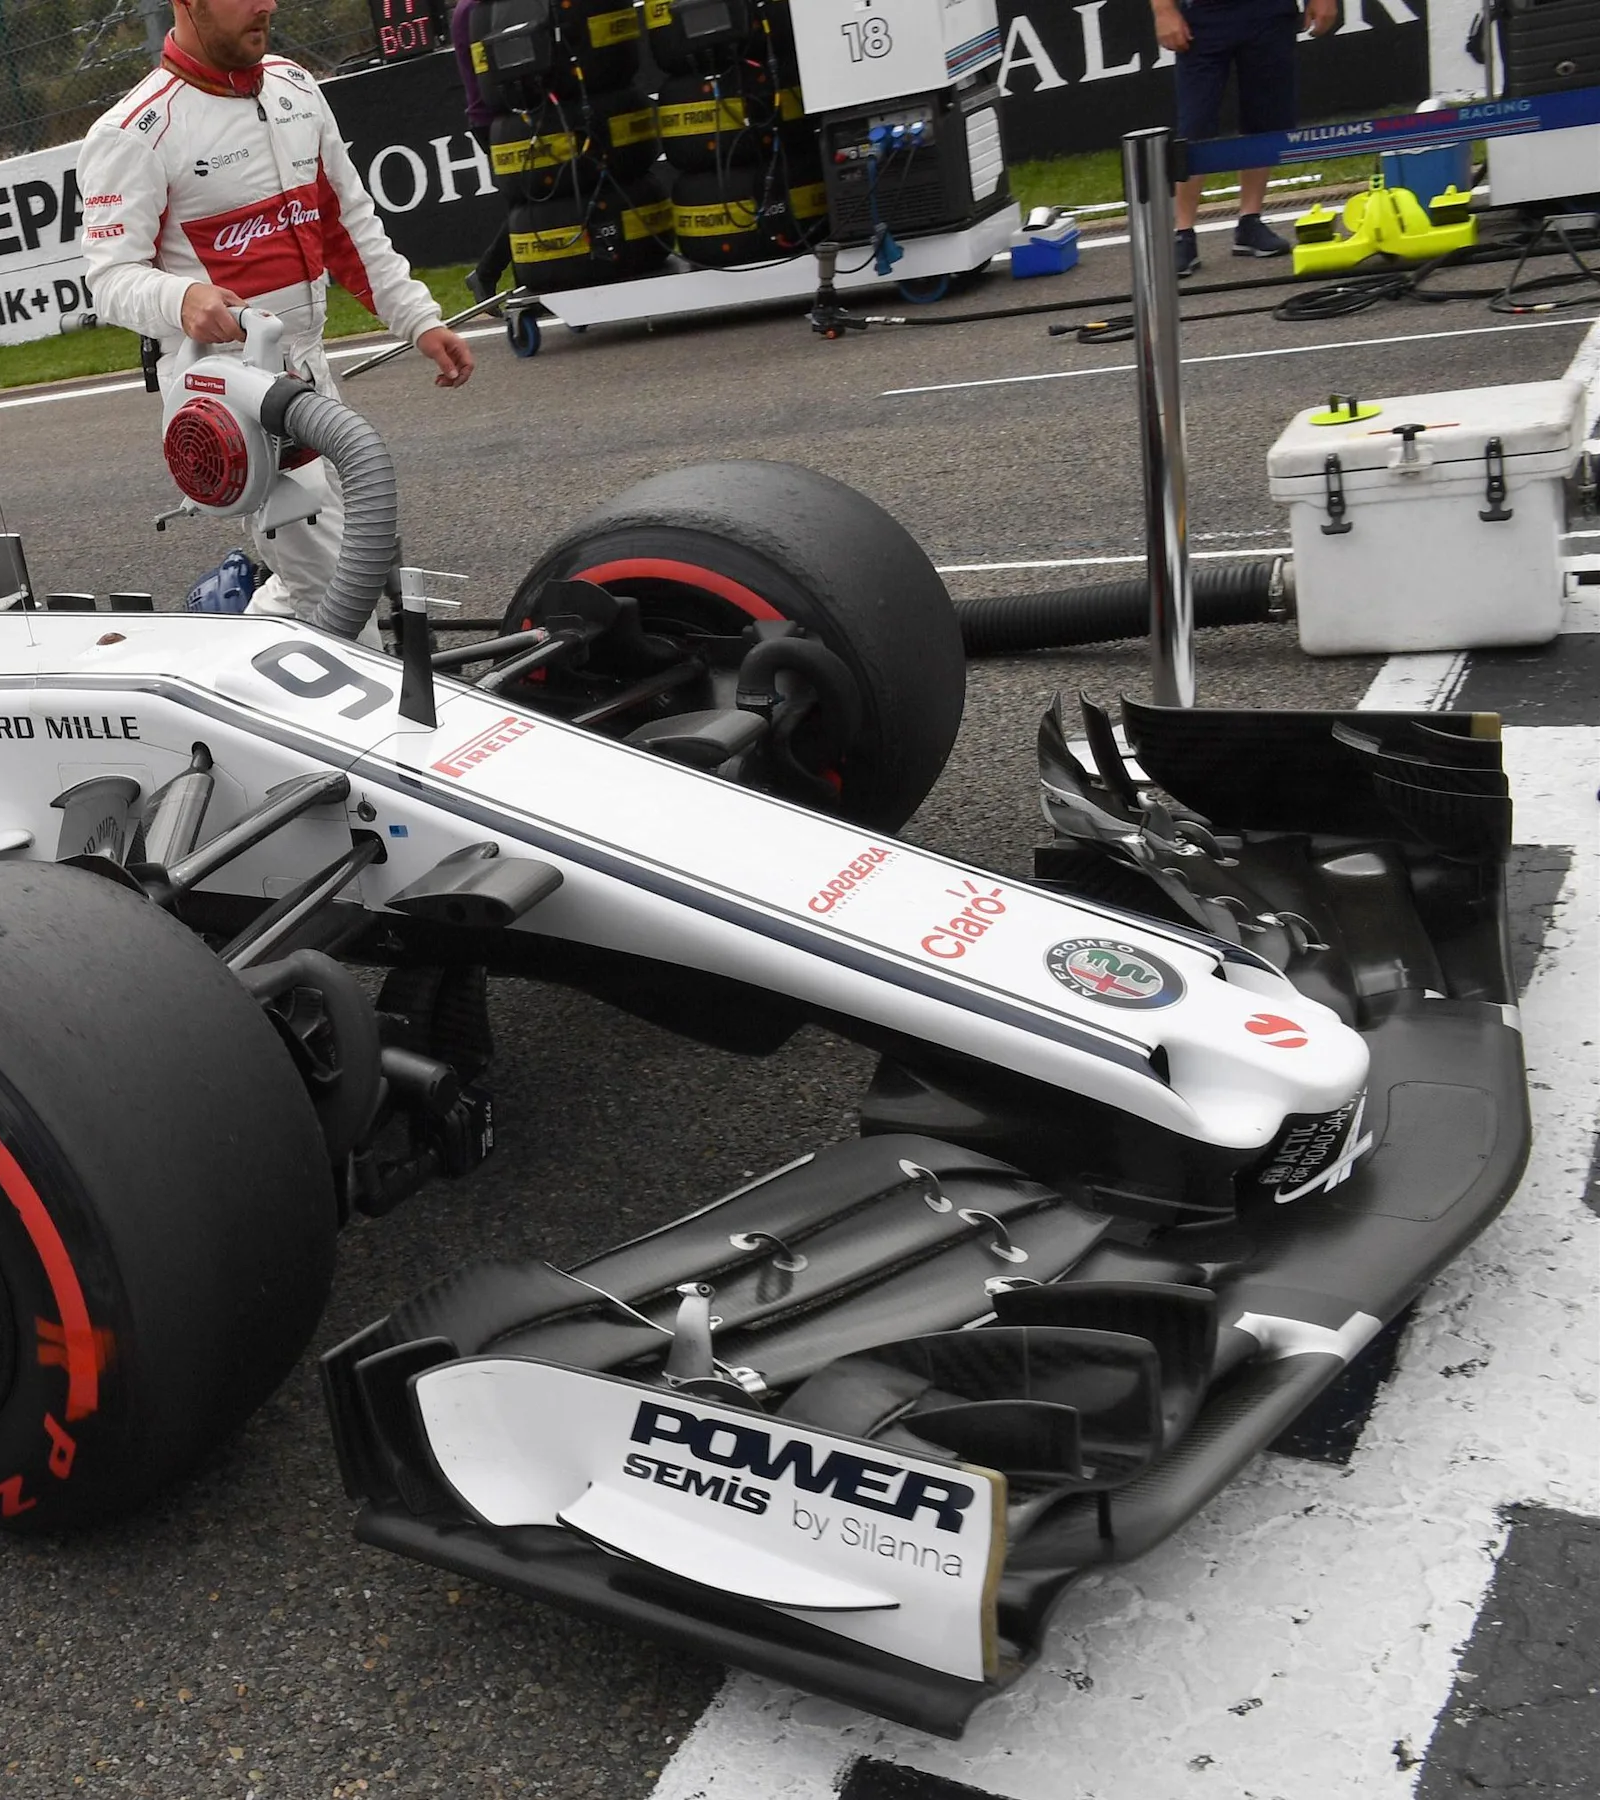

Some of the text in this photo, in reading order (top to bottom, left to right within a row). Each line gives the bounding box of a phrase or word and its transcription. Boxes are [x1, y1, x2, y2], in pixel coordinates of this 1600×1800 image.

[379, 16, 429, 55] BOT
[841, 17, 893, 63] 18
[138, 110, 158, 131] OMP
[1287, 122, 1374, 143] WILLIAMS
[1459, 100, 1531, 121] RACING
[210, 148, 249, 170] Silanna
[84, 194, 123, 206] CARRERA
[214, 214, 276, 256] Alfa
[251, 640, 394, 721] 9
[45, 716, 141, 740] MILLE
[430, 716, 536, 778] PIRELLI
[807, 846, 892, 914] CARRERA
[920, 896, 1007, 959] Claro
[1050, 938, 1135, 998] ALFA ROMEO
[1288, 1166, 1312, 1183] FOR
[1300, 1134, 1336, 1165] ROAD
[44, 1412, 76, 1480] P
[630, 1400, 975, 1534] POWER
[792, 1497, 964, 1579] by Silanna
